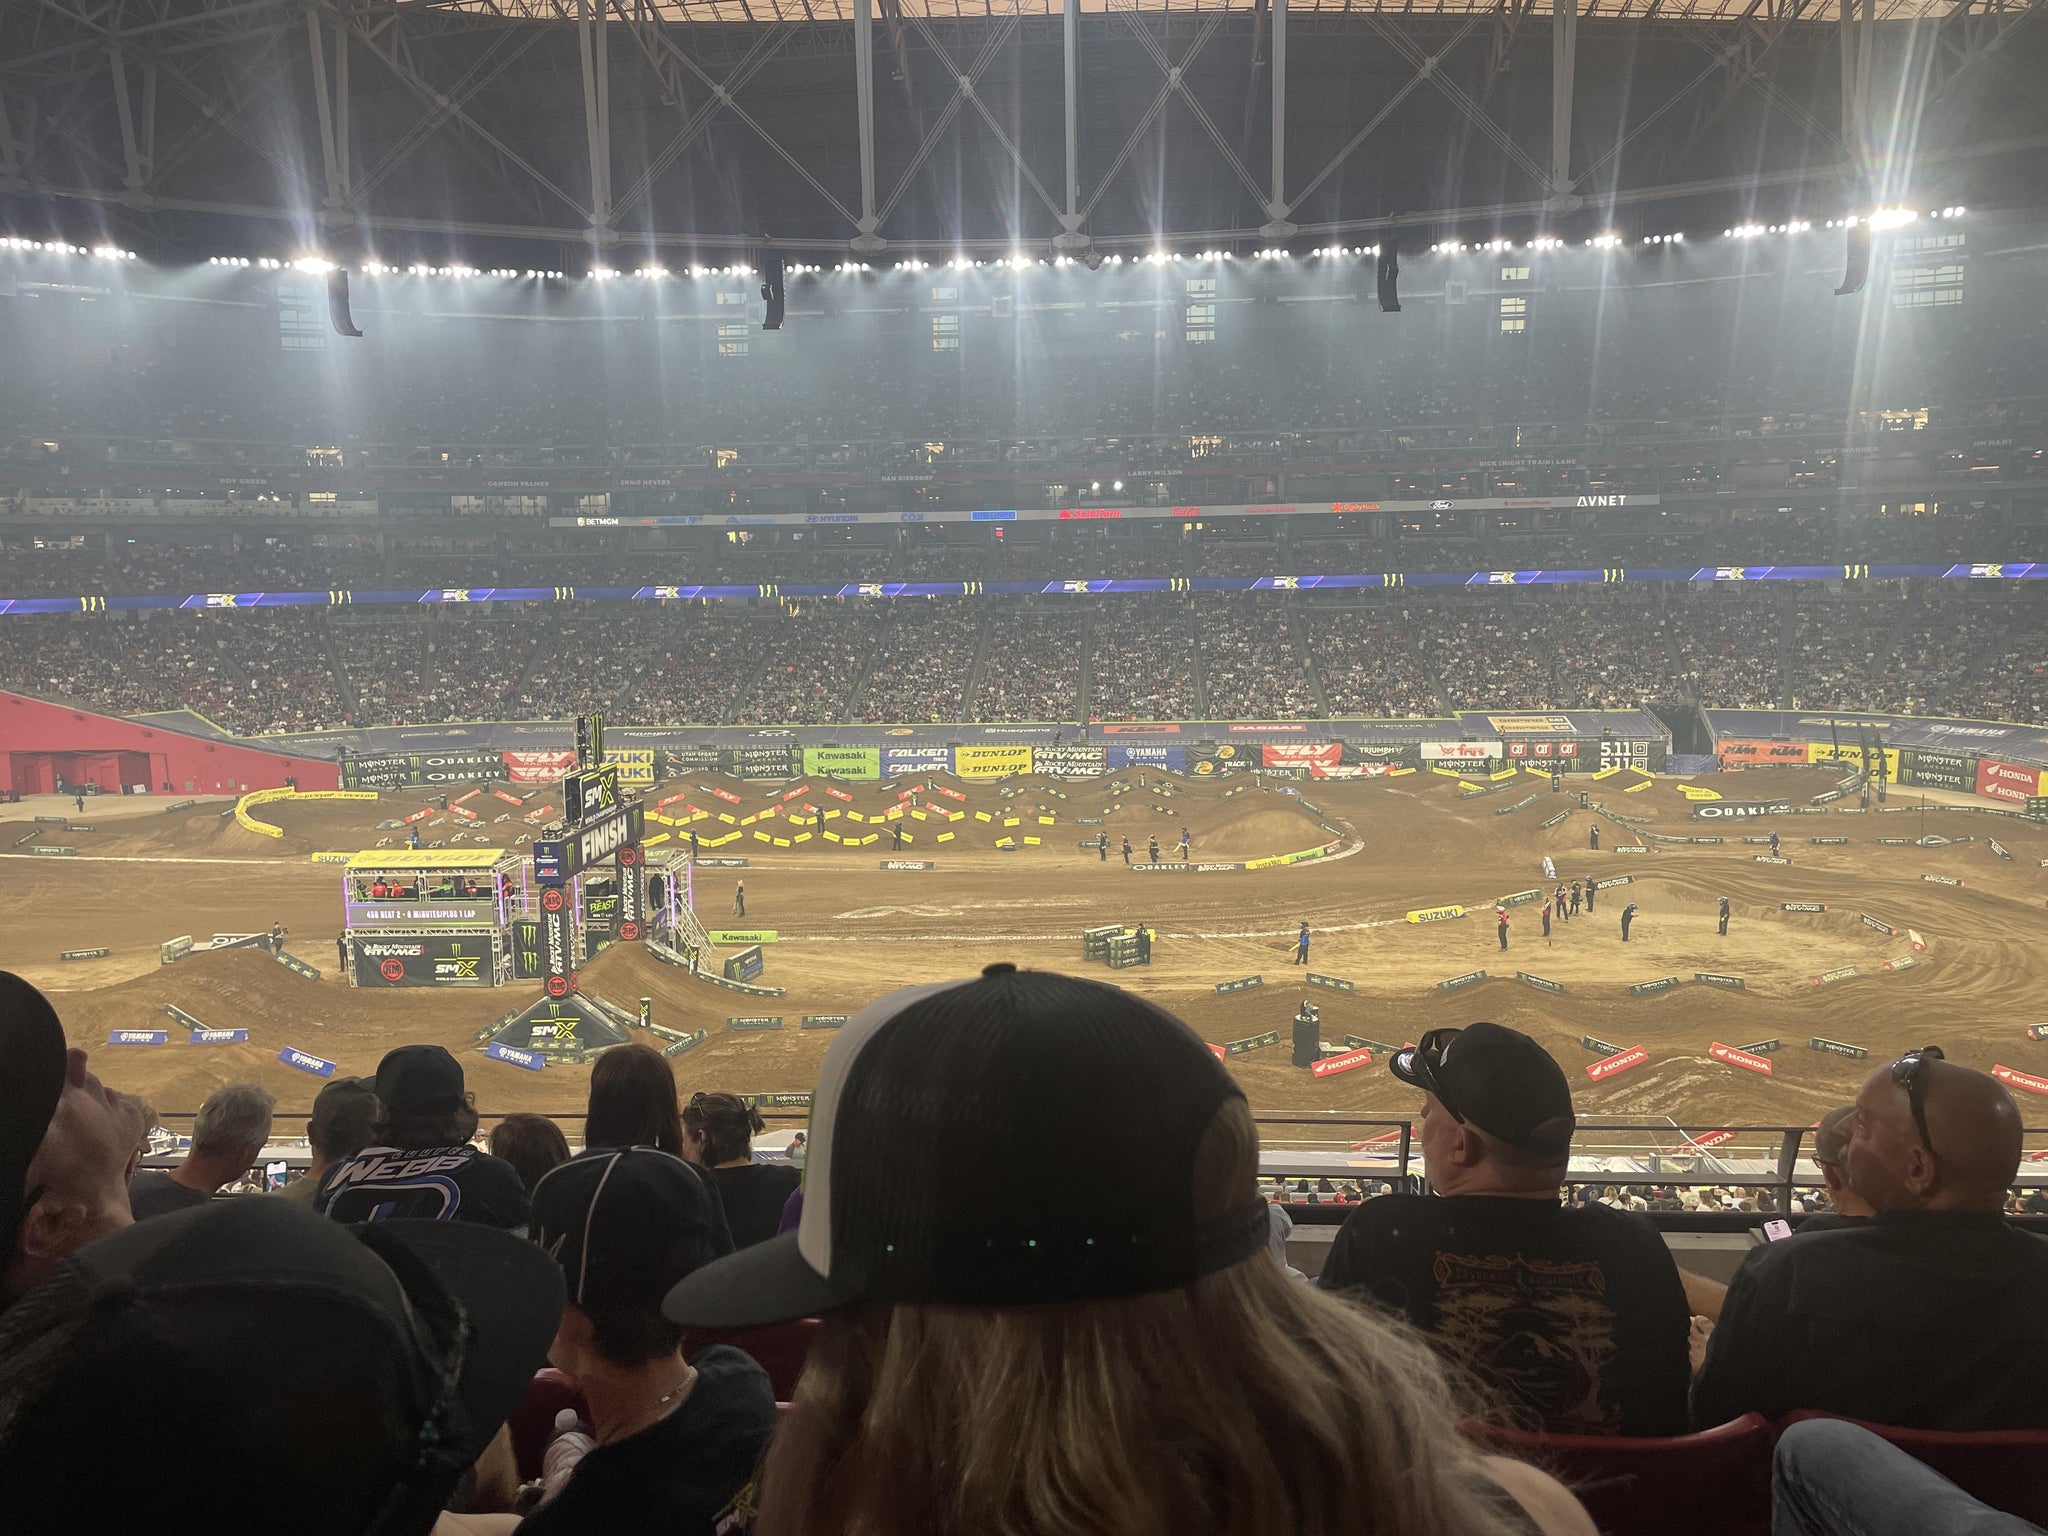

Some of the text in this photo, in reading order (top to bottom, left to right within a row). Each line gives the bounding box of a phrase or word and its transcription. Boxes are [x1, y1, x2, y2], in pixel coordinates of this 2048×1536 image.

[1841, 446, 1878, 454] WARNER
[1577, 495, 1627, 507] AVNET
[745, 750, 788, 759] MONSTER
[888, 749, 948, 758] FALKEN
[971, 749, 1027, 758] DUNLOP
[1136, 748, 1167, 757] YAMAHA
[1457, 744, 1485, 757] fry's
[1600, 742, 1632, 757] 5.11
[1724, 745, 1758, 755] KTM
[1769, 746, 1804, 756] KTM
[447, 755, 499, 765] OAKLEY
[587, 752, 650, 764] UZUKI
[817, 751, 866, 760] Kawasaki
[1918, 754, 1962, 767] MONSTER
[358, 759, 406, 769] MONSTER
[746, 764, 788, 773] MONSTER
[888, 764, 948, 774] FALKEN
[972, 764, 1027, 773] DUNLOP
[1044, 760, 1066, 768] ROCKY
[1438, 760, 1486, 768] MONSTER
[447, 771, 500, 780] OAKLEY
[817, 766, 866, 775] Kawasaki
[362, 774, 407, 784] MONSTER
[1916, 772, 1961, 785] MONSTER
[1999, 770, 2033, 784] HONDA
[584, 772, 614, 809] SMX
[1997, 787, 2027, 800] HOND
[582, 814, 628, 866] FINISH
[590, 899, 617, 914] BEAST
[396, 910, 400, 918] 2
[464, 910, 476, 918] LAP
[1418, 909, 1459, 922] SUZUKI
[722, 933, 762, 942] Kawasaki
[435, 961, 478, 977] SMX
[1450, 974, 1476, 985] MONSTER
[1643, 980, 1668, 989] MONSTER
[531, 1022, 577, 1039] SMX
[1826, 1044, 1855, 1055] MONSTER
[506, 1048, 532, 1064] YAMAHA
[1604, 1052, 1645, 1069] HONDA
[299, 1054, 324, 1070] YAMAHA
[1326, 1055, 1368, 1071] HONDA
[1728, 1054, 1769, 1070] HONDA
[323, 1156, 469, 1192] WEBB
